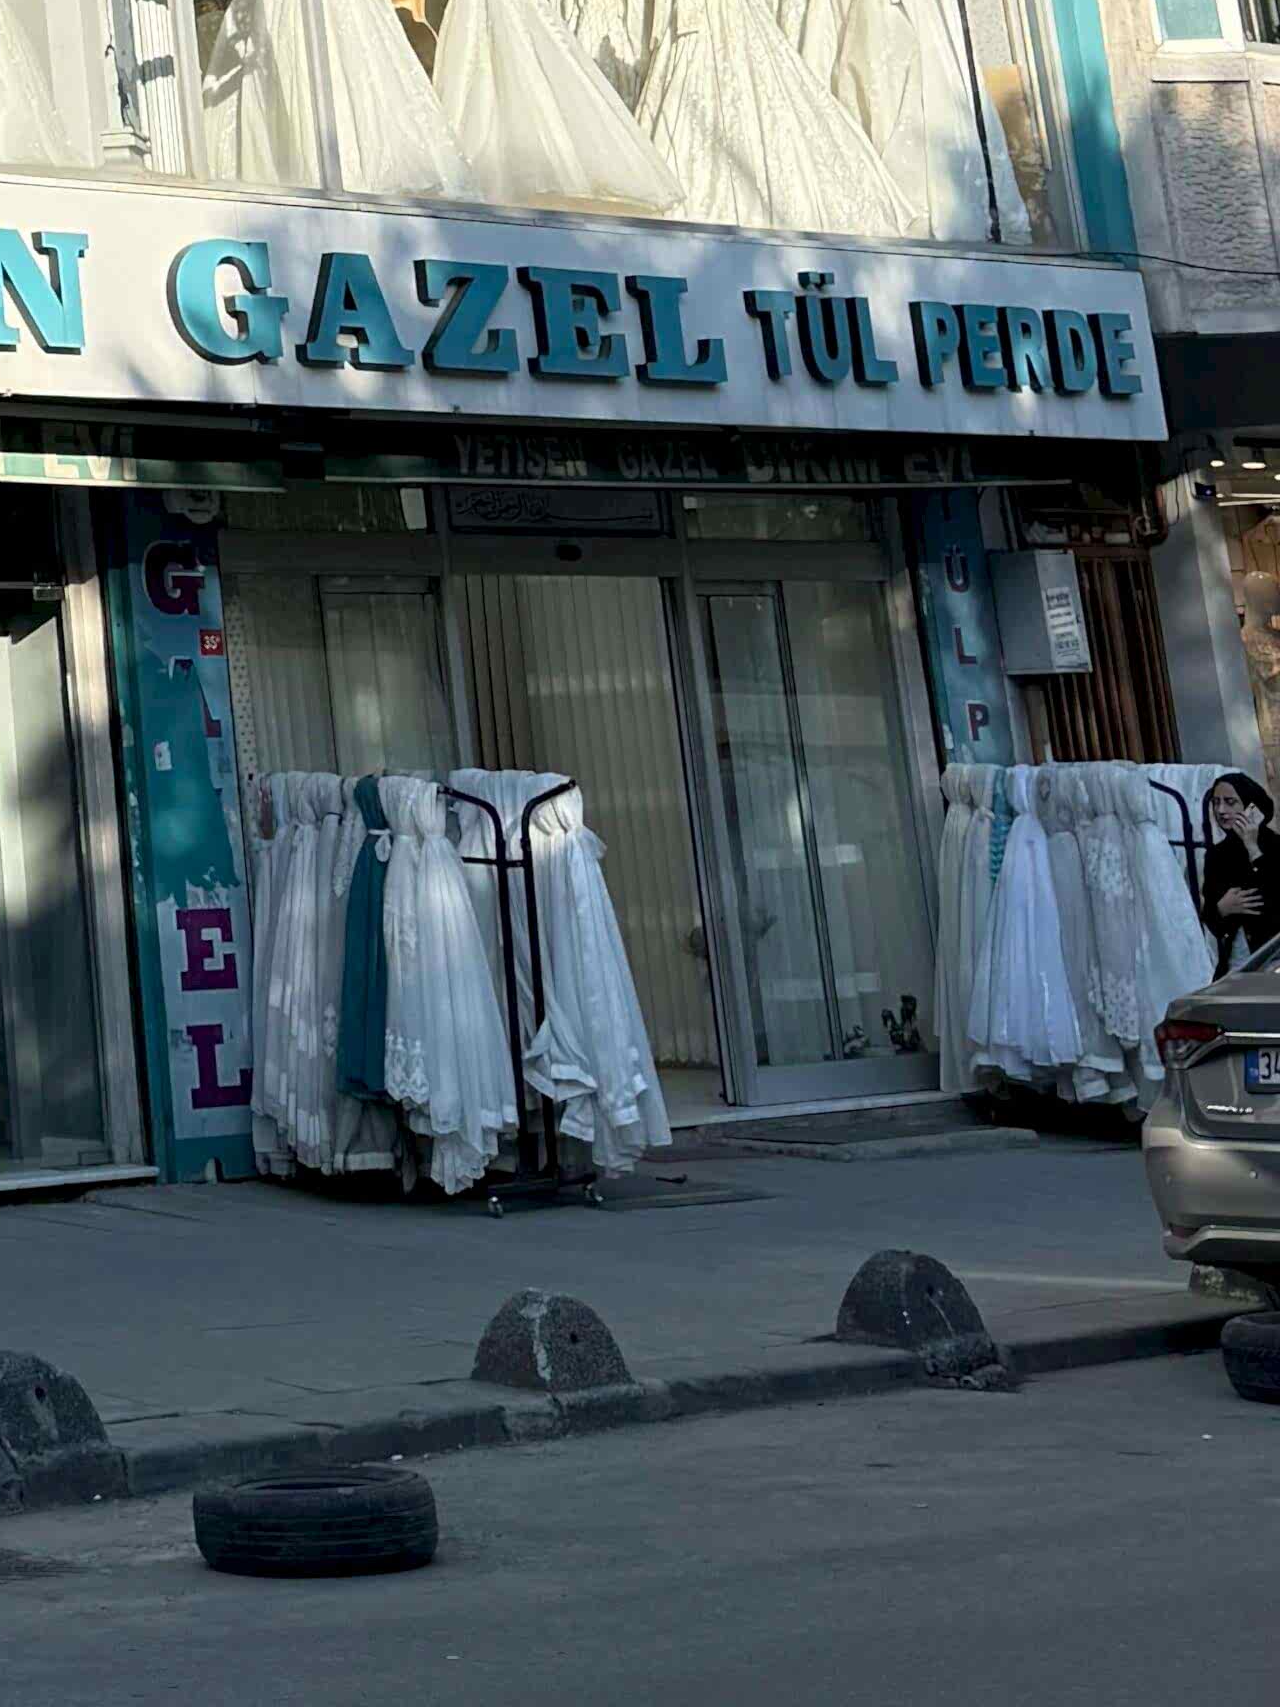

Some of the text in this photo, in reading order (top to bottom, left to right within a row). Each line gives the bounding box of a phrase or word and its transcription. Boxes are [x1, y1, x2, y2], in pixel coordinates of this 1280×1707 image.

[170, 239, 729, 387] GAZEL
[748, 271, 899, 387] TÜL
[914, 301, 1144, 395] PERDE
[41, 421, 140, 483] EVİ
